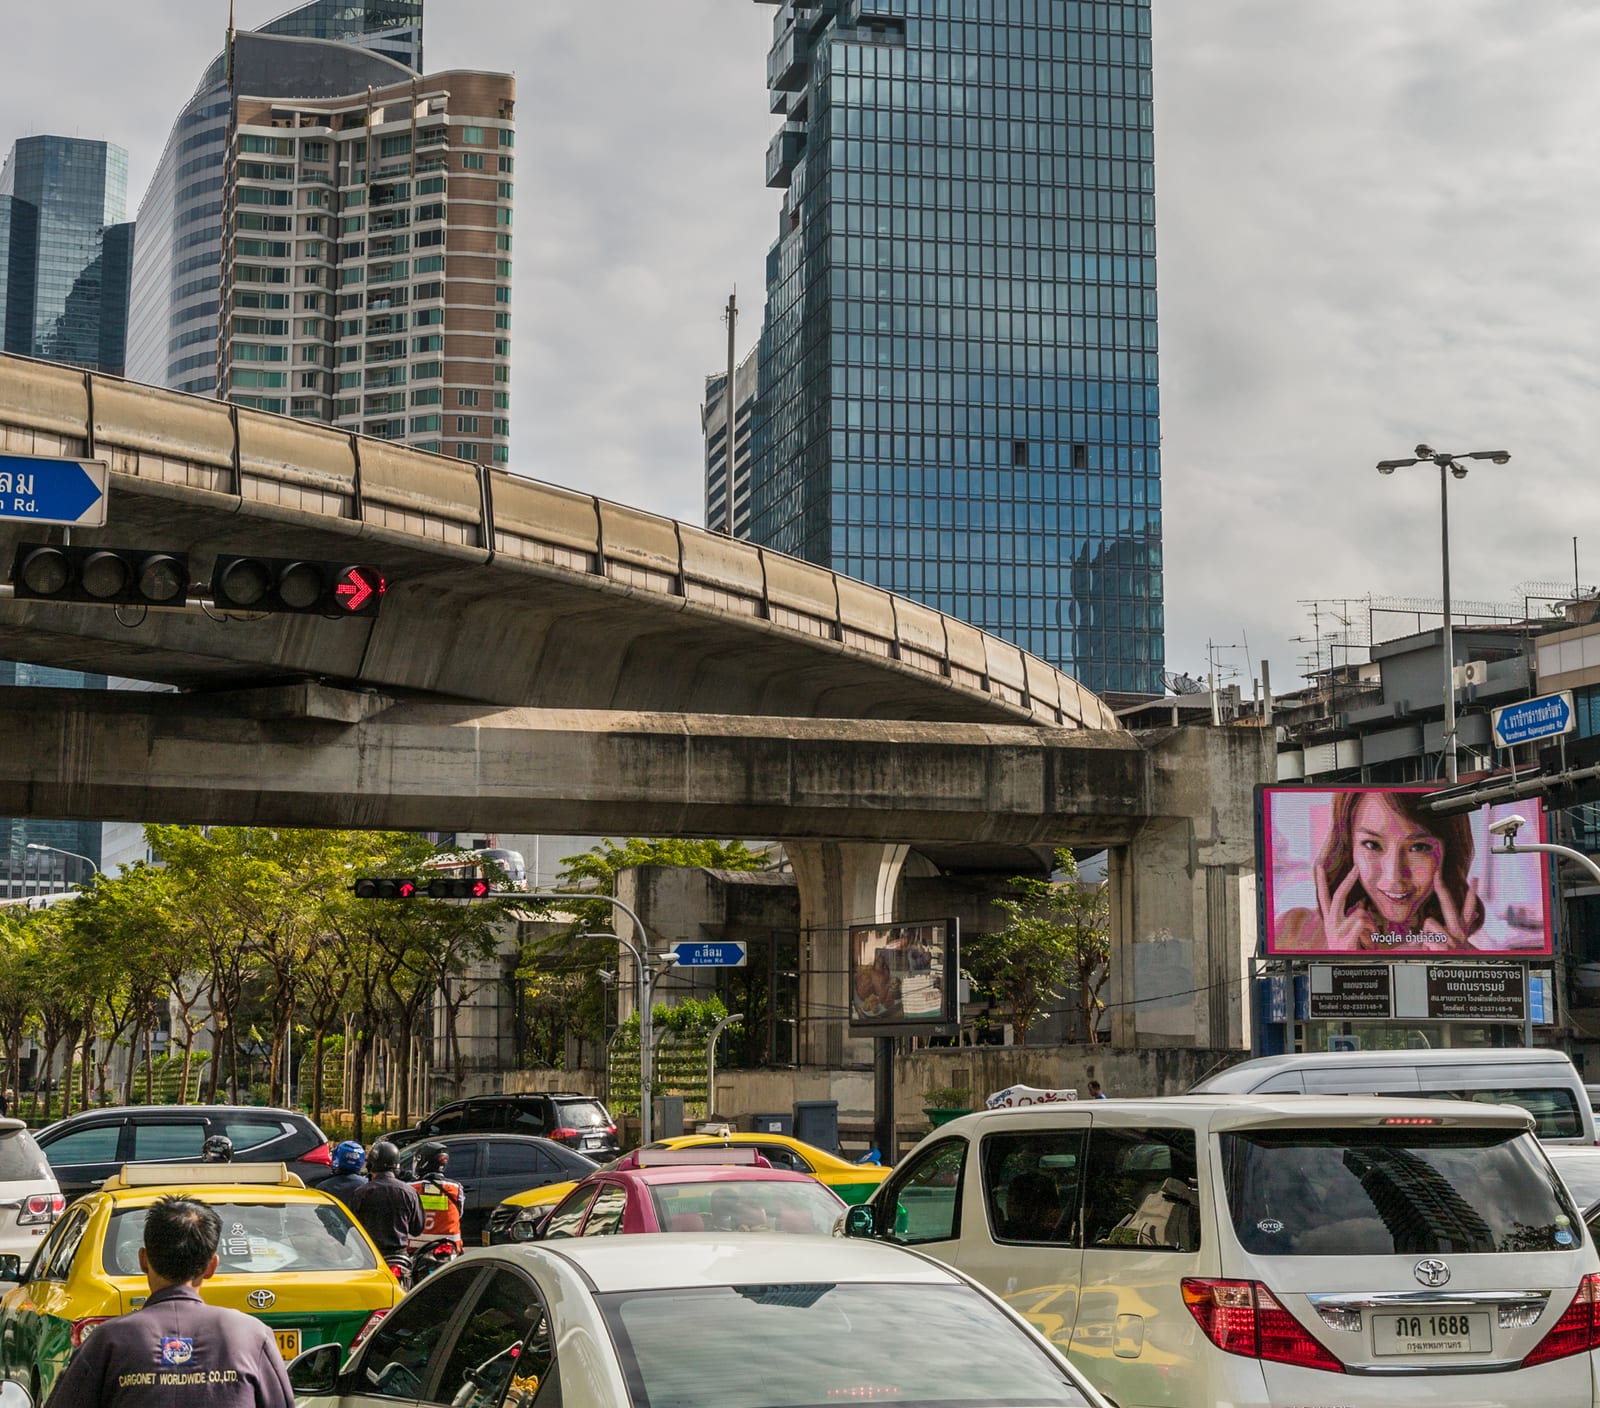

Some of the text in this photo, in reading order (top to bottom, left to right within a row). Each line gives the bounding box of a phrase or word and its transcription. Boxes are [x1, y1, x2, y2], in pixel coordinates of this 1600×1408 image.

[14, 498, 39, 512] Rd.
[1429, 967, 1520, 981] ตู้ควบคุมการจราจร
[1447, 980, 1505, 991] แยกนรารมย์
[1429, 1315, 1470, 1336] 1688
[119, 1373, 157, 1387] CARGONET
[160, 1372, 206, 1385] WORLDWIDE
